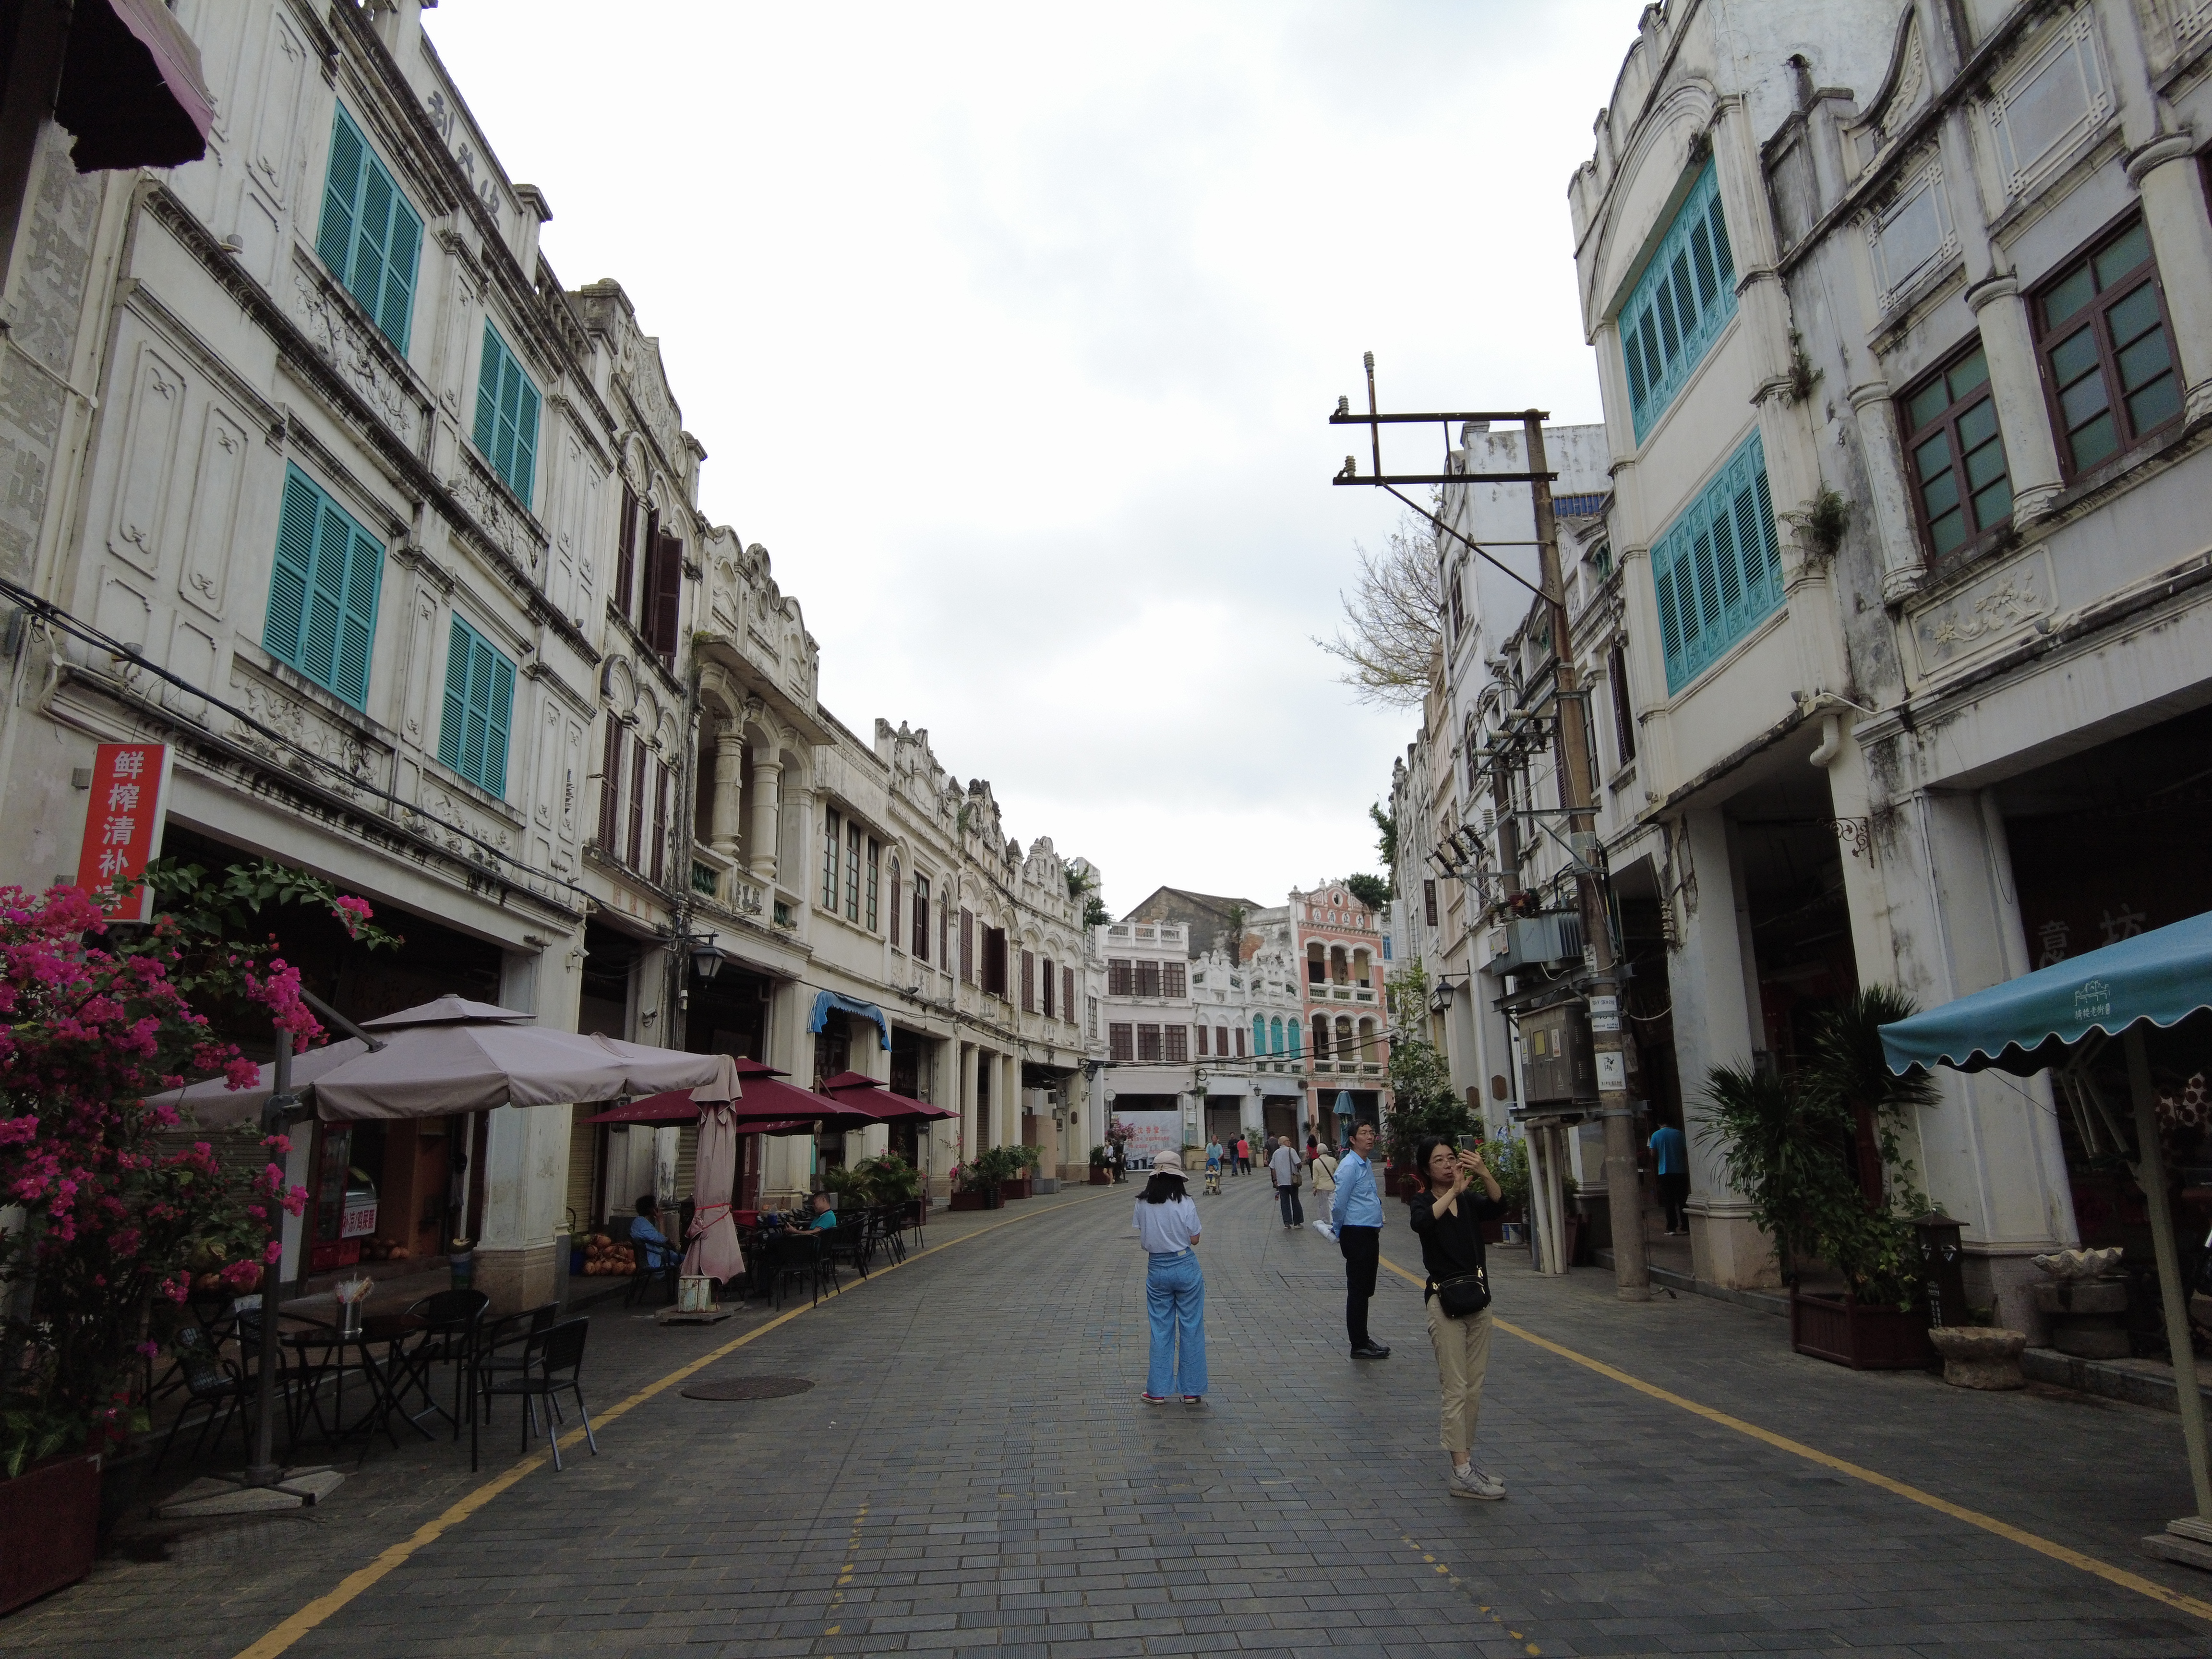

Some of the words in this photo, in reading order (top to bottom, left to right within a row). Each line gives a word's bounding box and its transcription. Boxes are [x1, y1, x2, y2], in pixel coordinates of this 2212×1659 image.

[95, 751, 144, 911] 鲜榨清补凉
